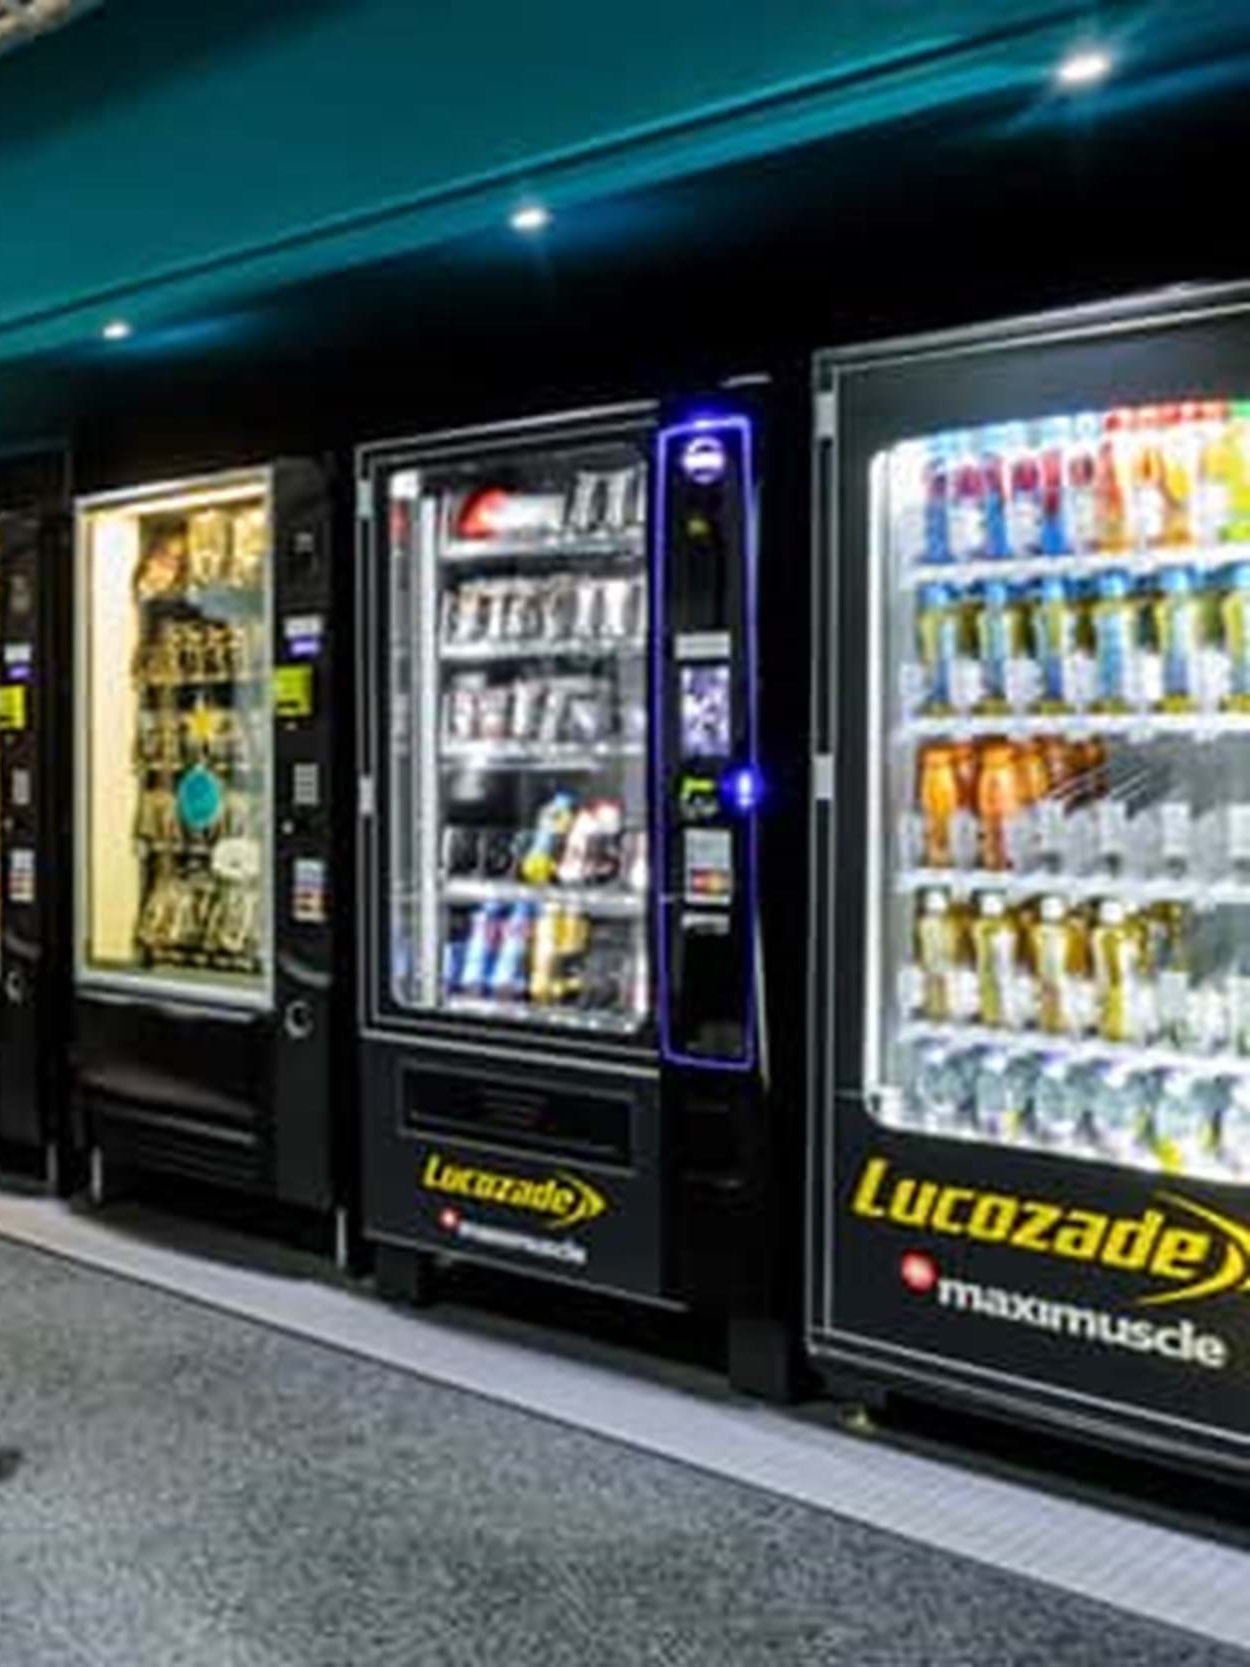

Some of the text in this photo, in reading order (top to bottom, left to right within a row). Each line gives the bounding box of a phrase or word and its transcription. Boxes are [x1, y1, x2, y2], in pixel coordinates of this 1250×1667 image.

[424, 1155, 575, 1216] Lucozade
[852, 1157, 1212, 1279] Lucozade
[938, 1278, 1228, 1368] maximuscle
